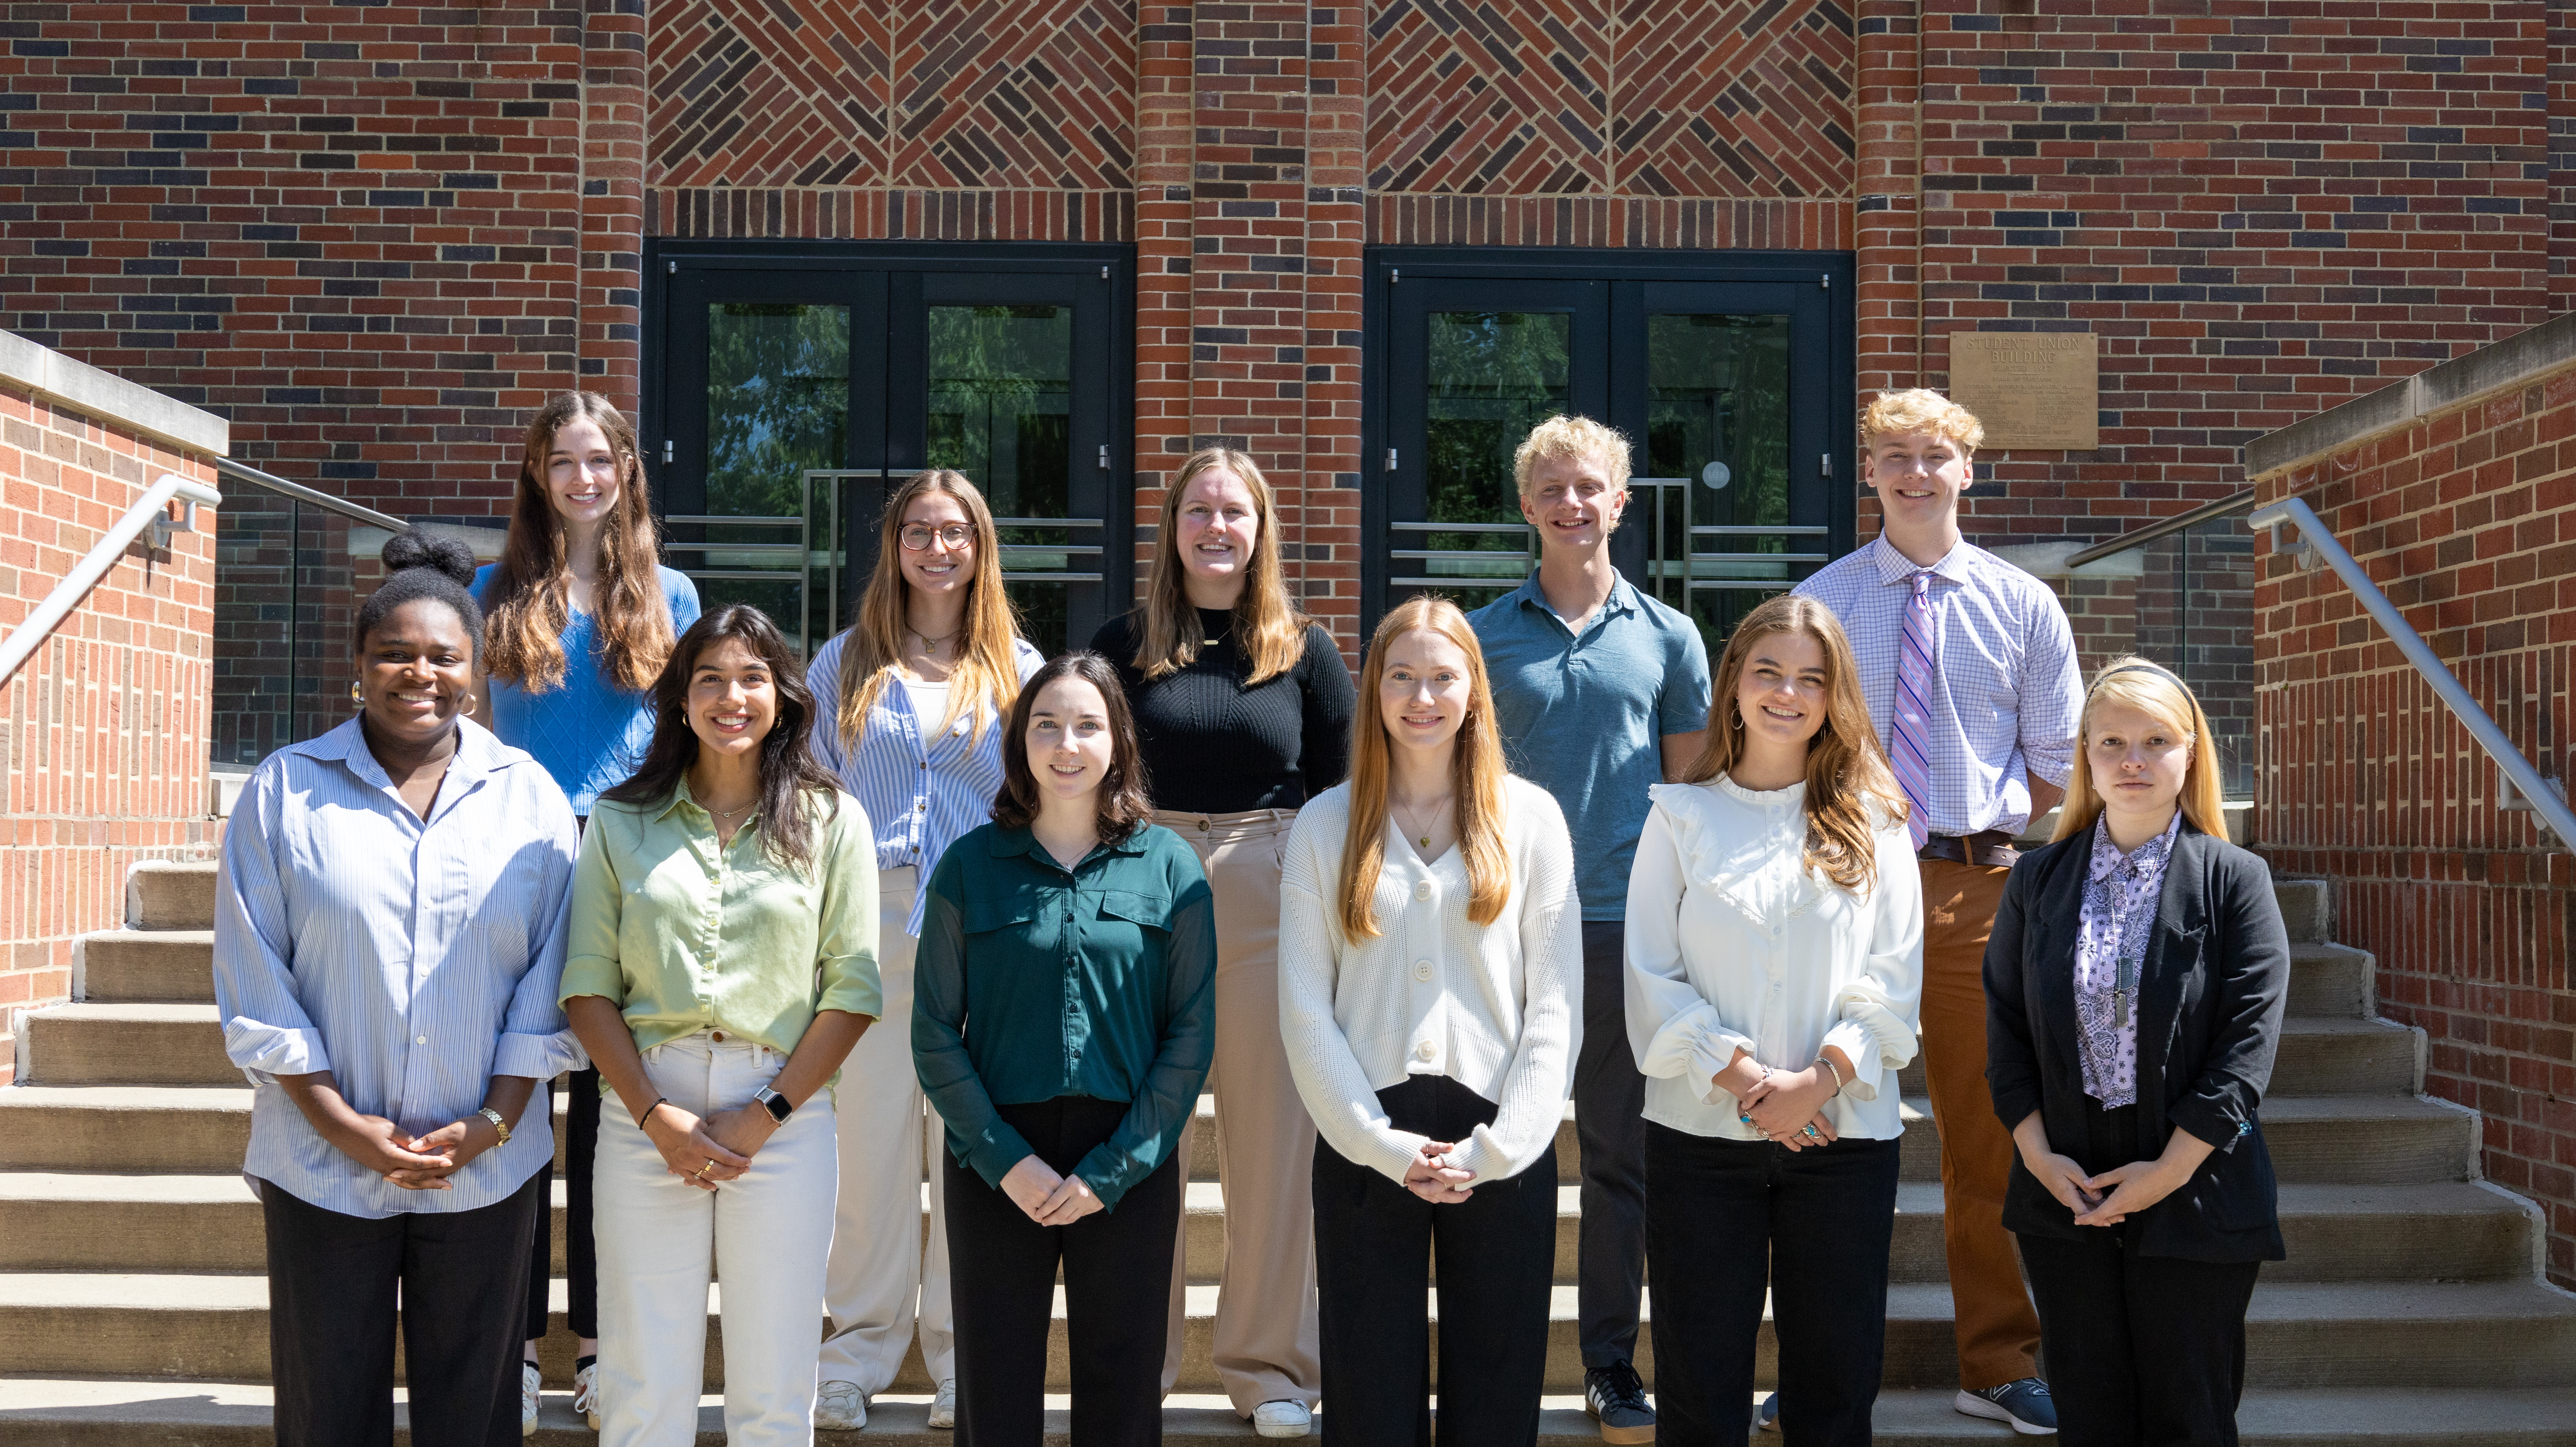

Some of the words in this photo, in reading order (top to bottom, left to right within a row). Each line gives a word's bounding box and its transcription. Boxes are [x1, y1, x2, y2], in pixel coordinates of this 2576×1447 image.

[1967, 337, 2029, 349] STUDENT
[2039, 338, 2080, 349] UNION
[1991, 351, 2056, 363] BUILDING
